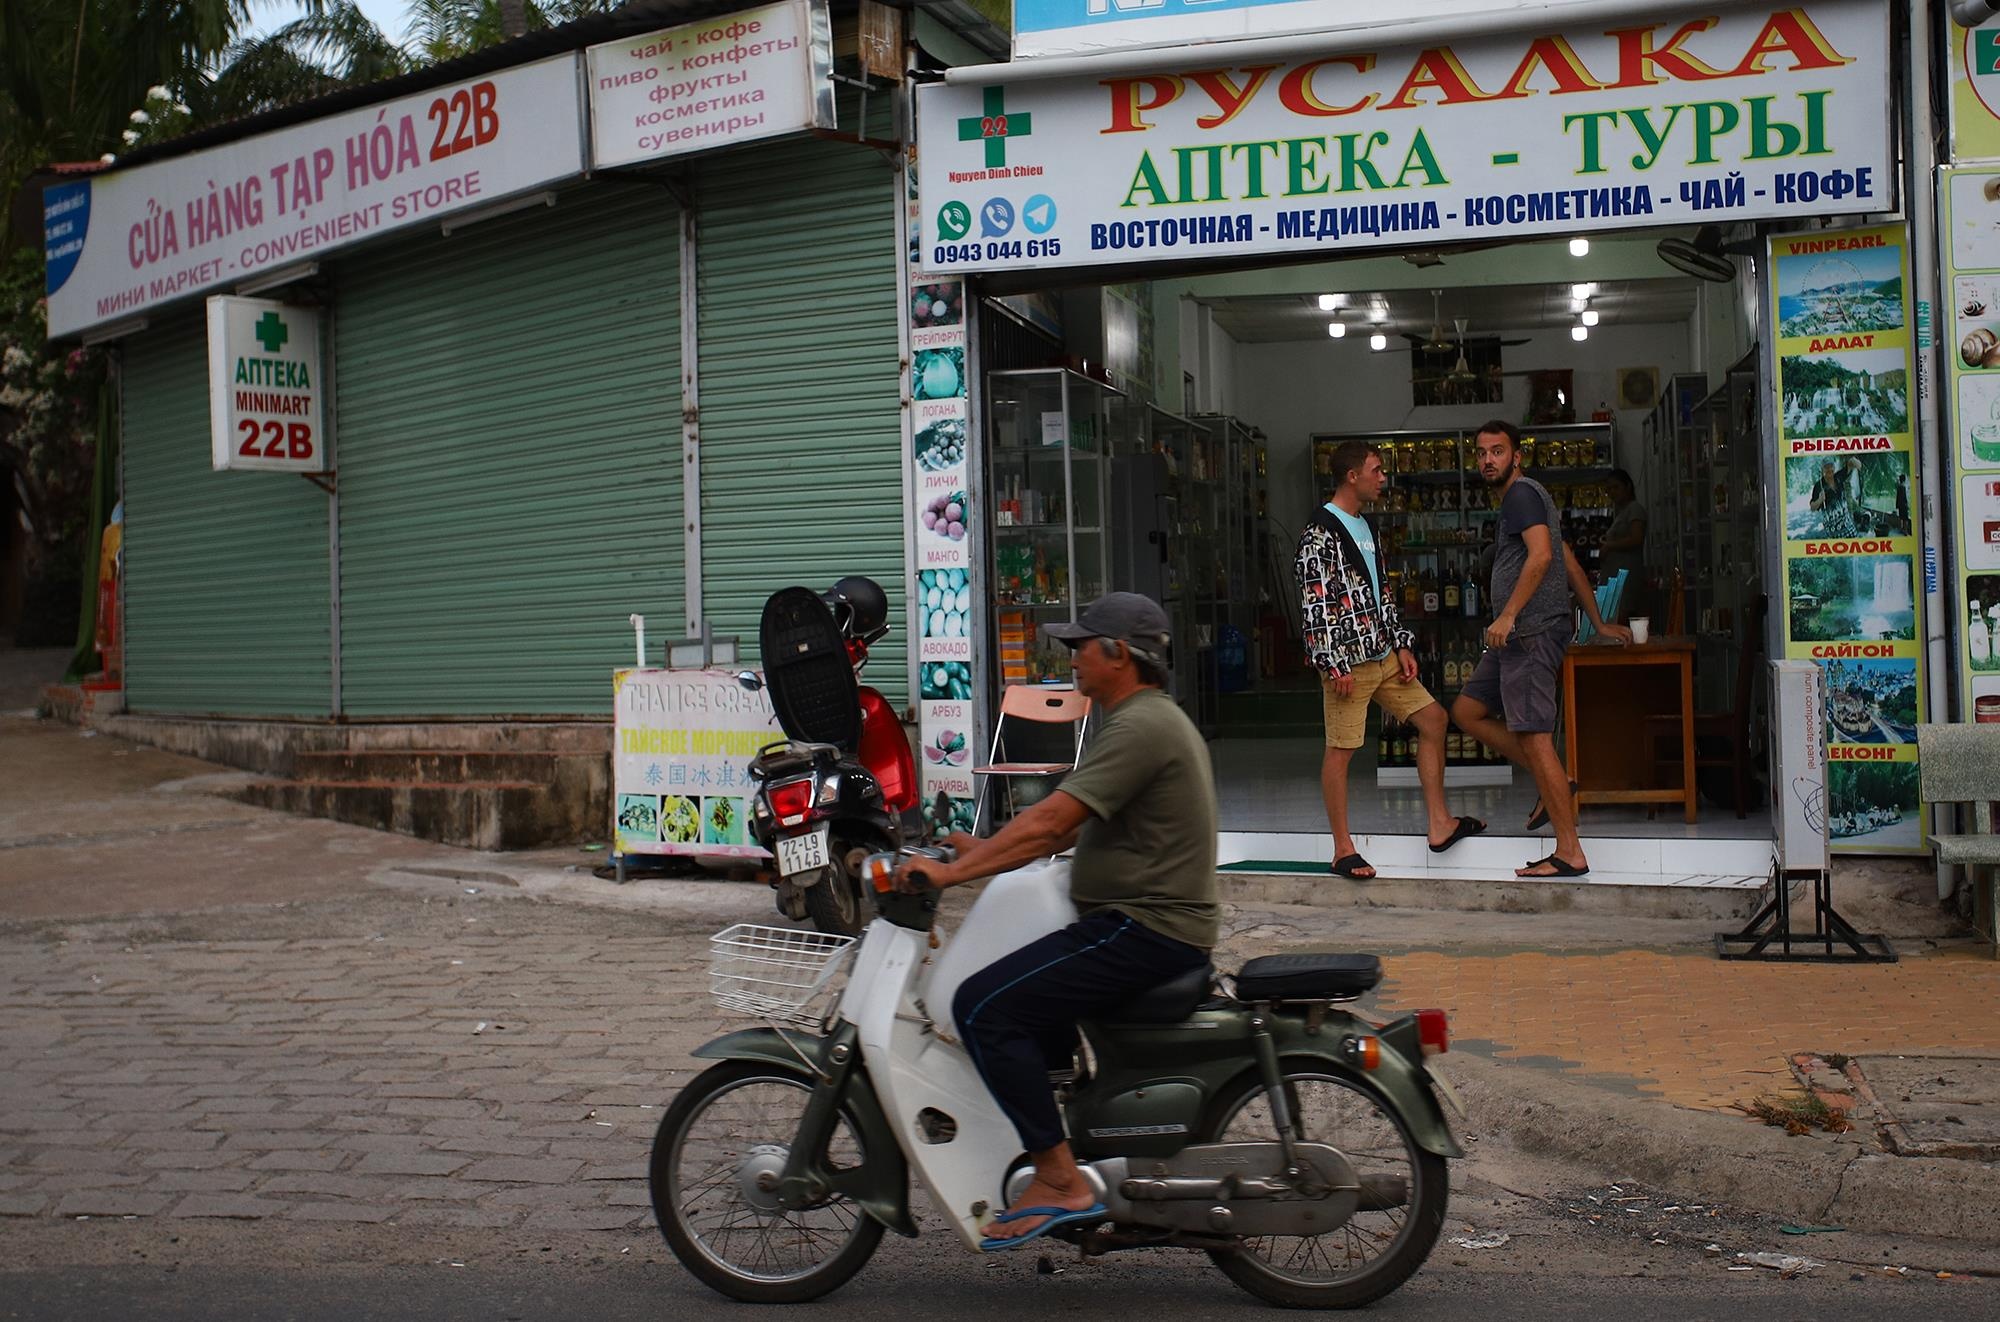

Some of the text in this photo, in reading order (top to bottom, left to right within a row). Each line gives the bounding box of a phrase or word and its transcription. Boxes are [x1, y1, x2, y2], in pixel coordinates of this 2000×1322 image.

[630, 37, 673, 60] чай
[697, 20, 762, 46] кофе
[599, 67, 659, 91] пиво
[682, 35, 799, 72] конфеты
[1100, 8, 1857, 135] РУСАЛКА
[649, 69, 748, 104] фрукты
[635, 89, 765, 128] косметика
[638, 112, 765, 150] сувениры
[981, 115, 1008, 138] 22
[1120, 126, 1451, 208] АПТЕКА
[1563, 90, 1835, 175] ТУРЫ
[128, 80, 499, 270] CỬA HÀNG TẠP HÓA 22B
[949, 171, 986, 184] Nguyen
[1013, 165, 1043, 177] Chieu
[1091, 214, 1253, 250] ВОСТОЧНАЯ
[1277, 201, 1440, 241] МЕДИЦИНА
[1464, 185, 1653, 226] КОСМЕТИКА
[1680, 171, 1745, 211] ЧАЙ
[1775, 167, 1872, 203] КОФЕ
[97, 284, 145, 317] МИНИ
[150, 258, 223, 300] МАРКЕТ
[241, 203, 384, 269] CONVENIENT
[391, 170, 481, 220] STORE
[934, 238, 1061, 264] 0943 044 615
[1789, 234, 1886, 256] VINPEARL
[912, 329, 964, 347] ГРЕЙПФРУТ
[1809, 335, 1874, 352] ДАЛАТ
[236, 357, 310, 389] АПТЕКА
[236, 391, 311, 416] MINIMART
[922, 404, 957, 417] ЛОГАНА
[238, 418, 313, 459] 22B
[1792, 437, 1891, 453] РЫБАЛКА
[925, 476, 958, 488] ЛИЧИ
[927, 550, 960, 563] МАНГО
[1805, 540, 1893, 555] БАОЛОК
[923, 642, 968, 656] АВОКАДО
[1812, 644, 1894, 658] САЙГОН
[624, 683, 774, 713] THAI ICE CREA
[931, 705, 962, 719] АРБУЗ
[1805, 695, 1814, 742] composite
[621, 723, 688, 755] ТАЙСКОЕ
[1806, 745, 1816, 769] panel
[1827, 747, 1896, 760] ЕКОНГ
[927, 777, 969, 793] ГУАЙЯВА
[783, 834, 819, 856] 72-L9
[785, 851, 821, 873] 1146
